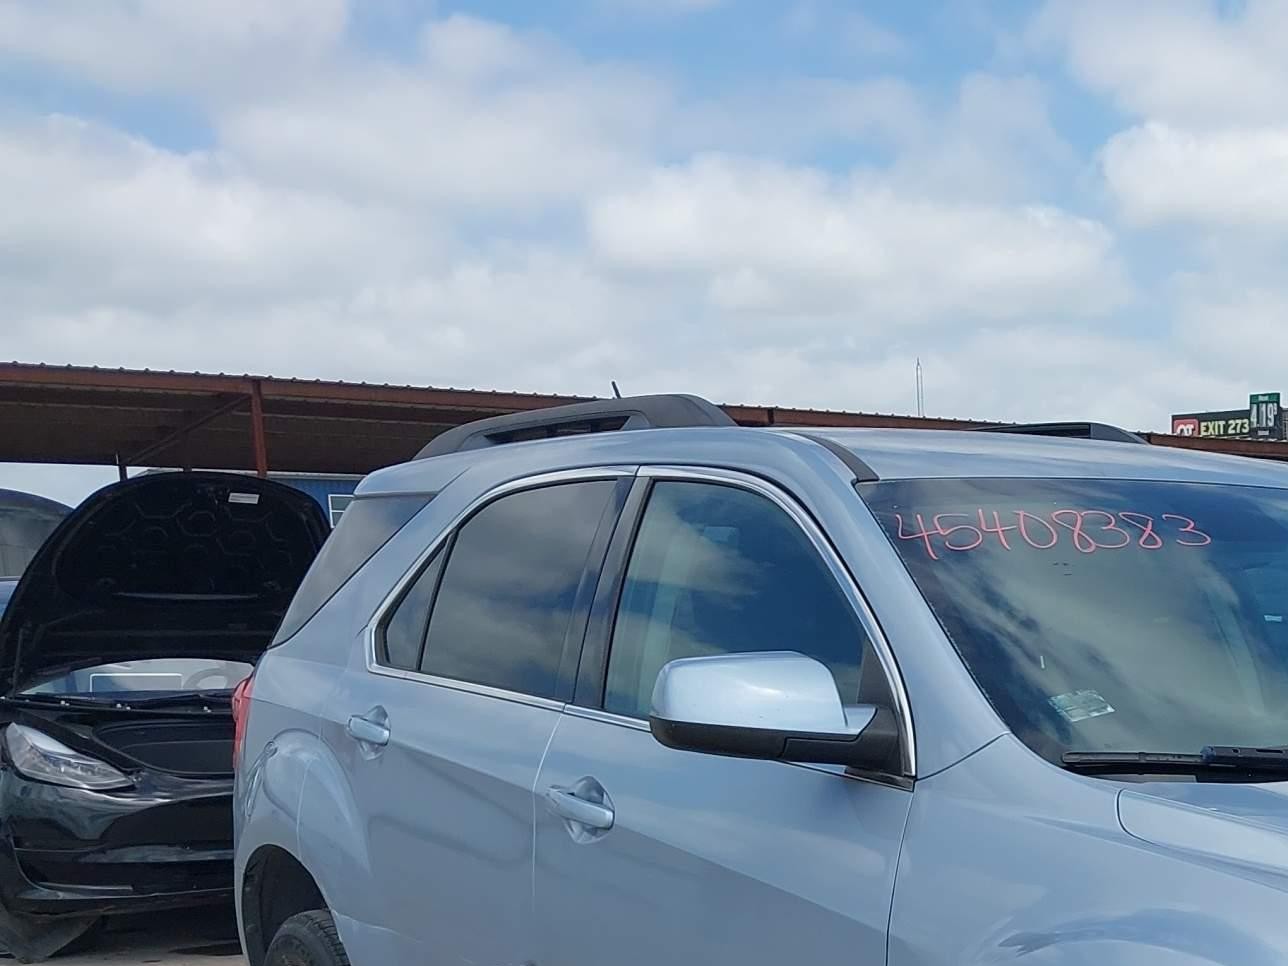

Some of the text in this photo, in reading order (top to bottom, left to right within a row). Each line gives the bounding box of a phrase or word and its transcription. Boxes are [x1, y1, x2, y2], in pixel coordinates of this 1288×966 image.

[1200, 421, 1227, 436] EXIT
[1228, 419, 1249, 434] 273
[895, 508, 1212, 560] 45408383
